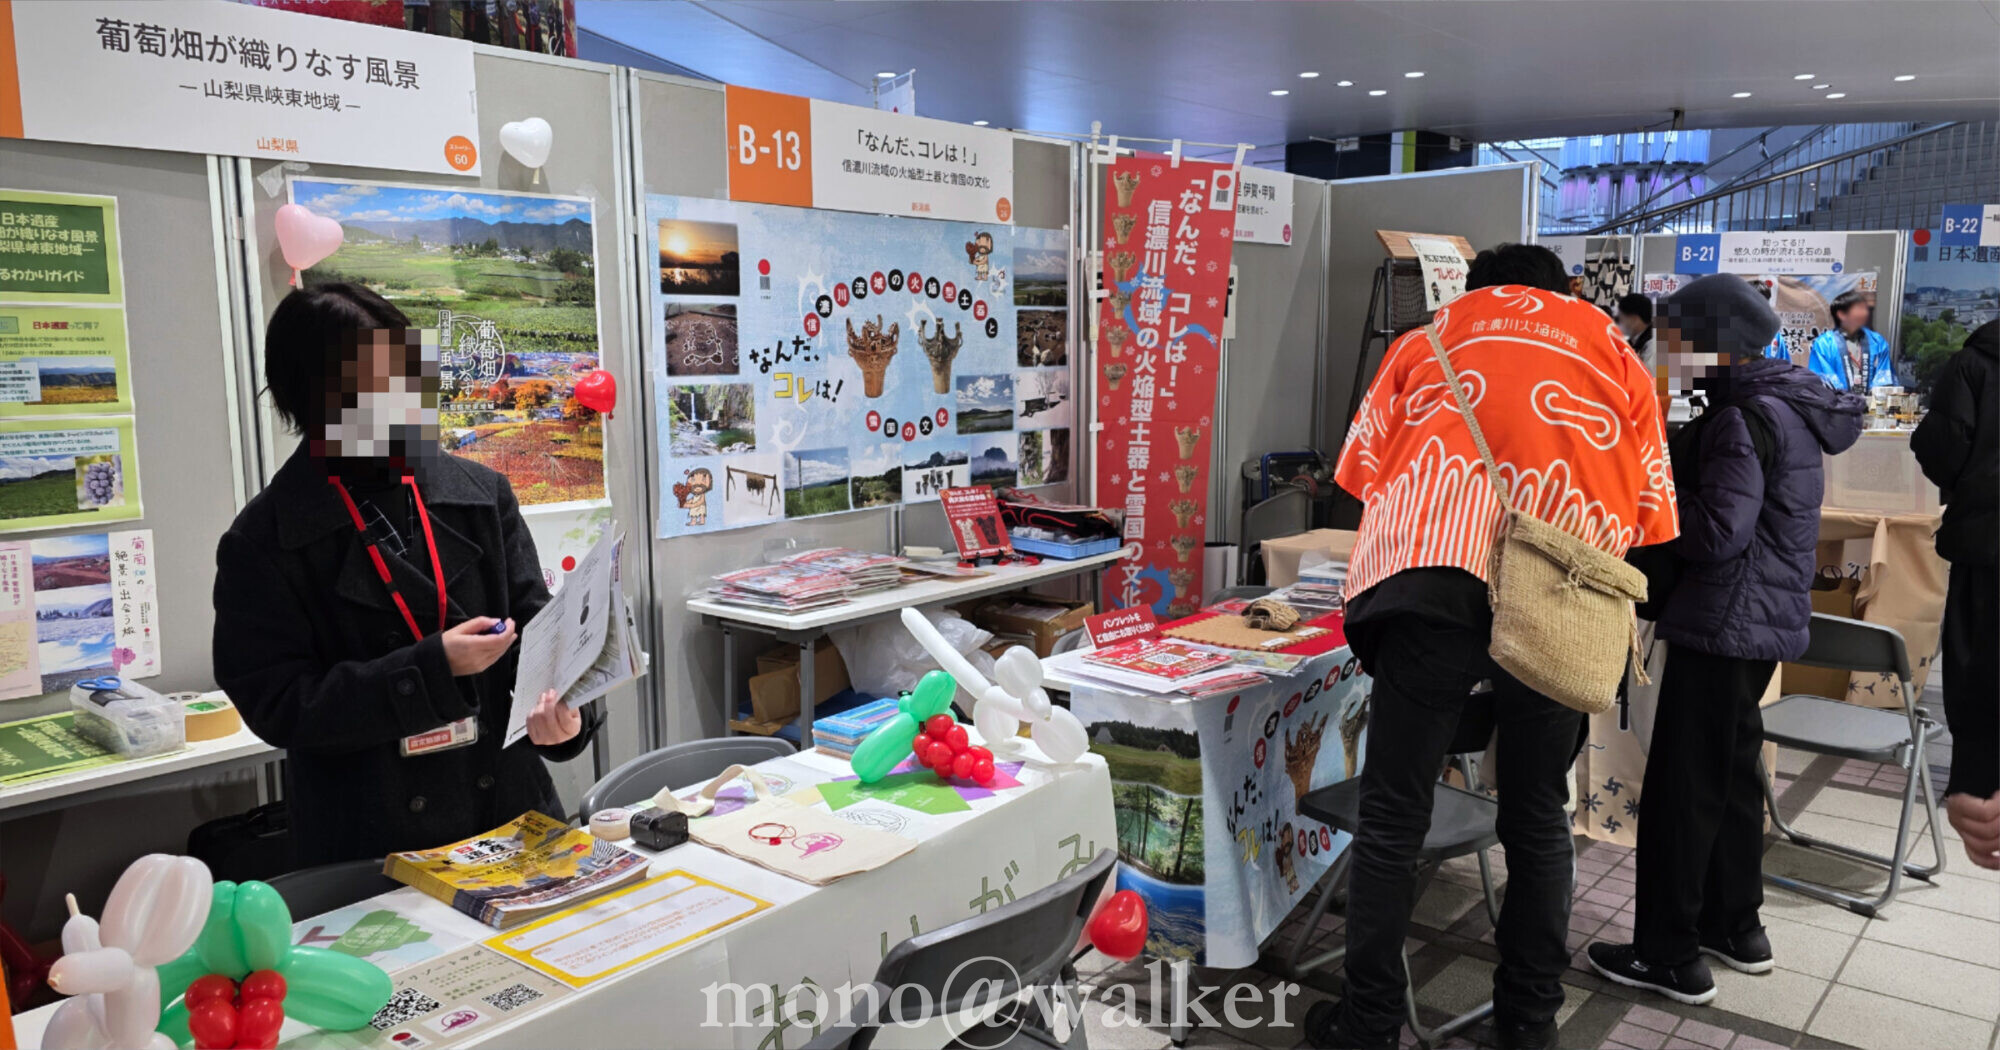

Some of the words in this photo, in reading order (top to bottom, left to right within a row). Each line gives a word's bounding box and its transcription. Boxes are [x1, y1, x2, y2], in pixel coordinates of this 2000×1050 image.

[96, 17, 420, 90] 葡萄畑が織りなす風景
[256, 137, 300, 154] 山梨県
[738, 124, 801, 171] B-13
[454, 154, 468, 166] 60
[1945, 218, 1979, 233] B-22
[1681, 246, 1715, 262] B-21
